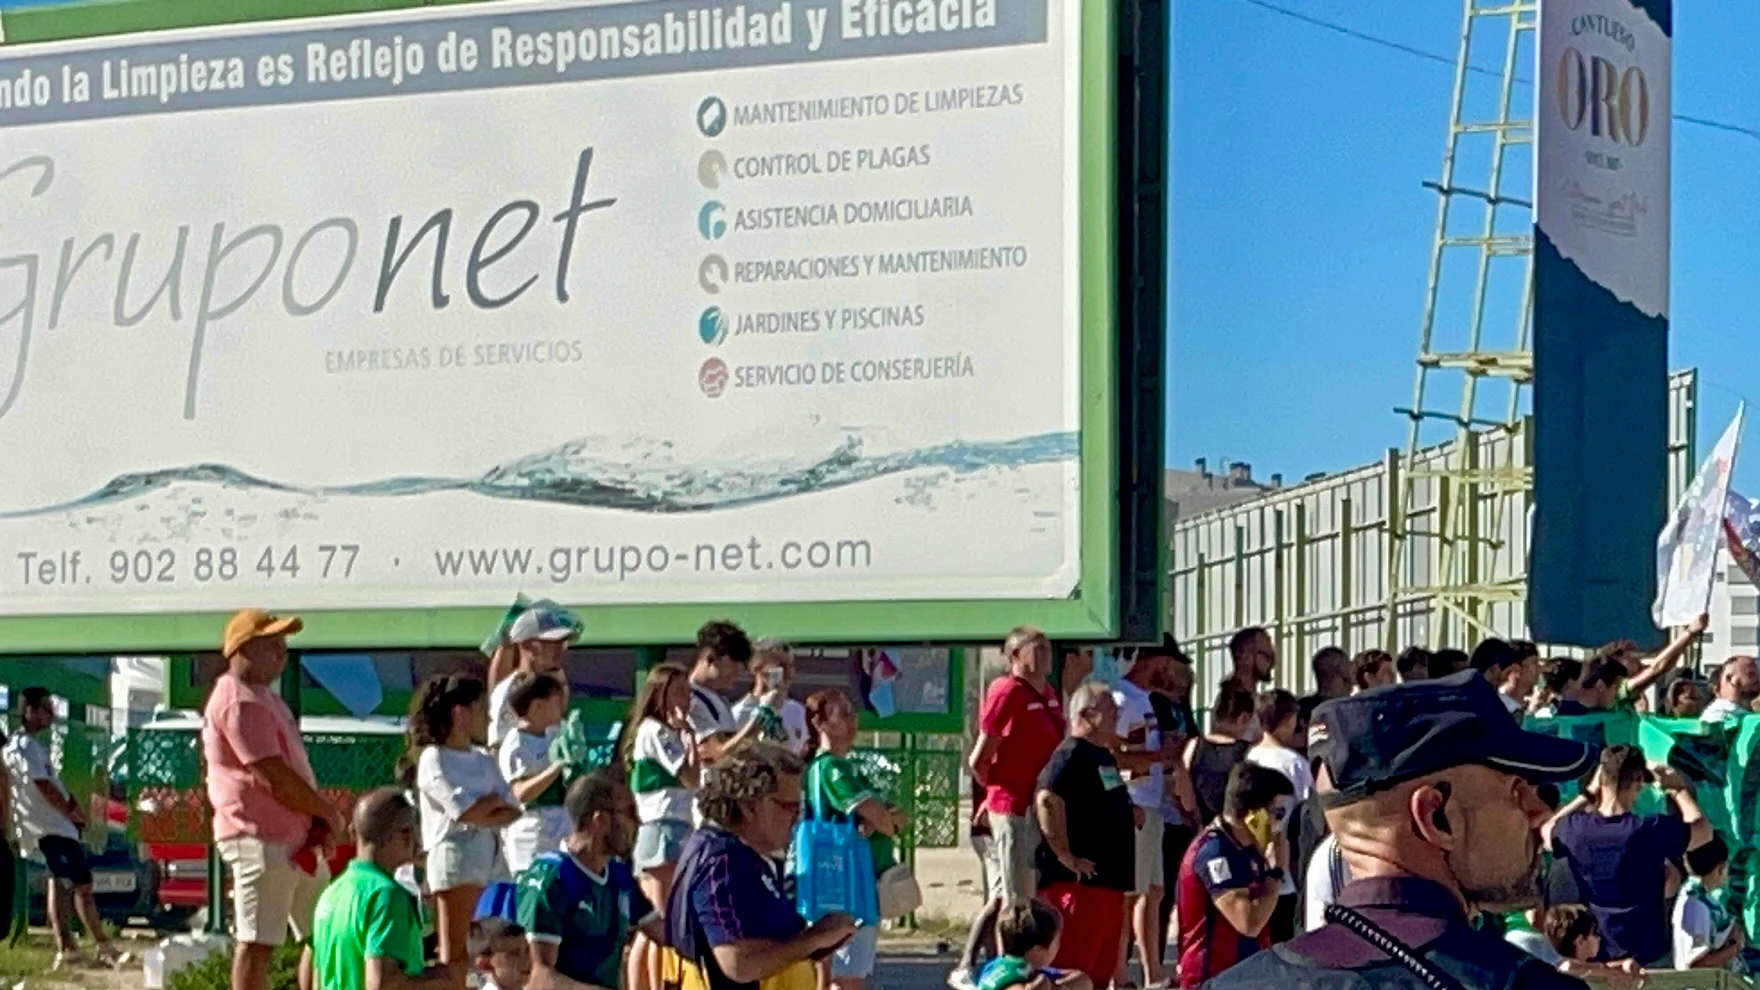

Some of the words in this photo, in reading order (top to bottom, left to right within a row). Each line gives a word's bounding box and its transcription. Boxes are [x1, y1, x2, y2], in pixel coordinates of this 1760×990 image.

[62, 65, 90, 104] la
[102, 53, 244, 104] Limpieza
[257, 53, 294, 88] es
[306, 36, 424, 85] Reflejo
[437, 31, 478, 73] de
[491, 1, 793, 73] Responsabilidad
[806, 8, 828, 51] y
[841, 0, 996, 41] Eficacia
[733, 94, 889, 126] MANTENIMIENTO
[894, 91, 920, 115] DE
[924, 83, 1024, 113] LIMPIEZAS
[1556, 46, 1650, 147] ORO
[733, 152, 822, 180] CONTROL
[827, 149, 852, 173] DE
[857, 144, 931, 170] PLAGAS
[734, 203, 839, 233] ASISTENCIA
[843, 195, 974, 225] DOMICILIARIA
[734, 256, 860, 284] REPARACIONES
[863, 255, 875, 276] Y
[878, 245, 1028, 275] MANTENIMIENTO
[734, 311, 821, 337] JARDINES
[824, 311, 837, 331] Y
[840, 304, 925, 330] PISCINAS
[325, 346, 431, 374] EMPRESAS
[438, 344, 466, 368] DE
[473, 340, 583, 367] SERVICIOS
[734, 361, 816, 388] SERVICIO
[821, 361, 846, 385] DE
[850, 353, 975, 383] CONSERJERÍA
[17, 550, 91, 585] Telf.
[109, 548, 176, 584] 902
[194, 546, 239, 582] 88
[255, 544, 301, 579] 44
[318, 544, 361, 579] 77
[434, 536, 872, 583] www.grupo-net.com
